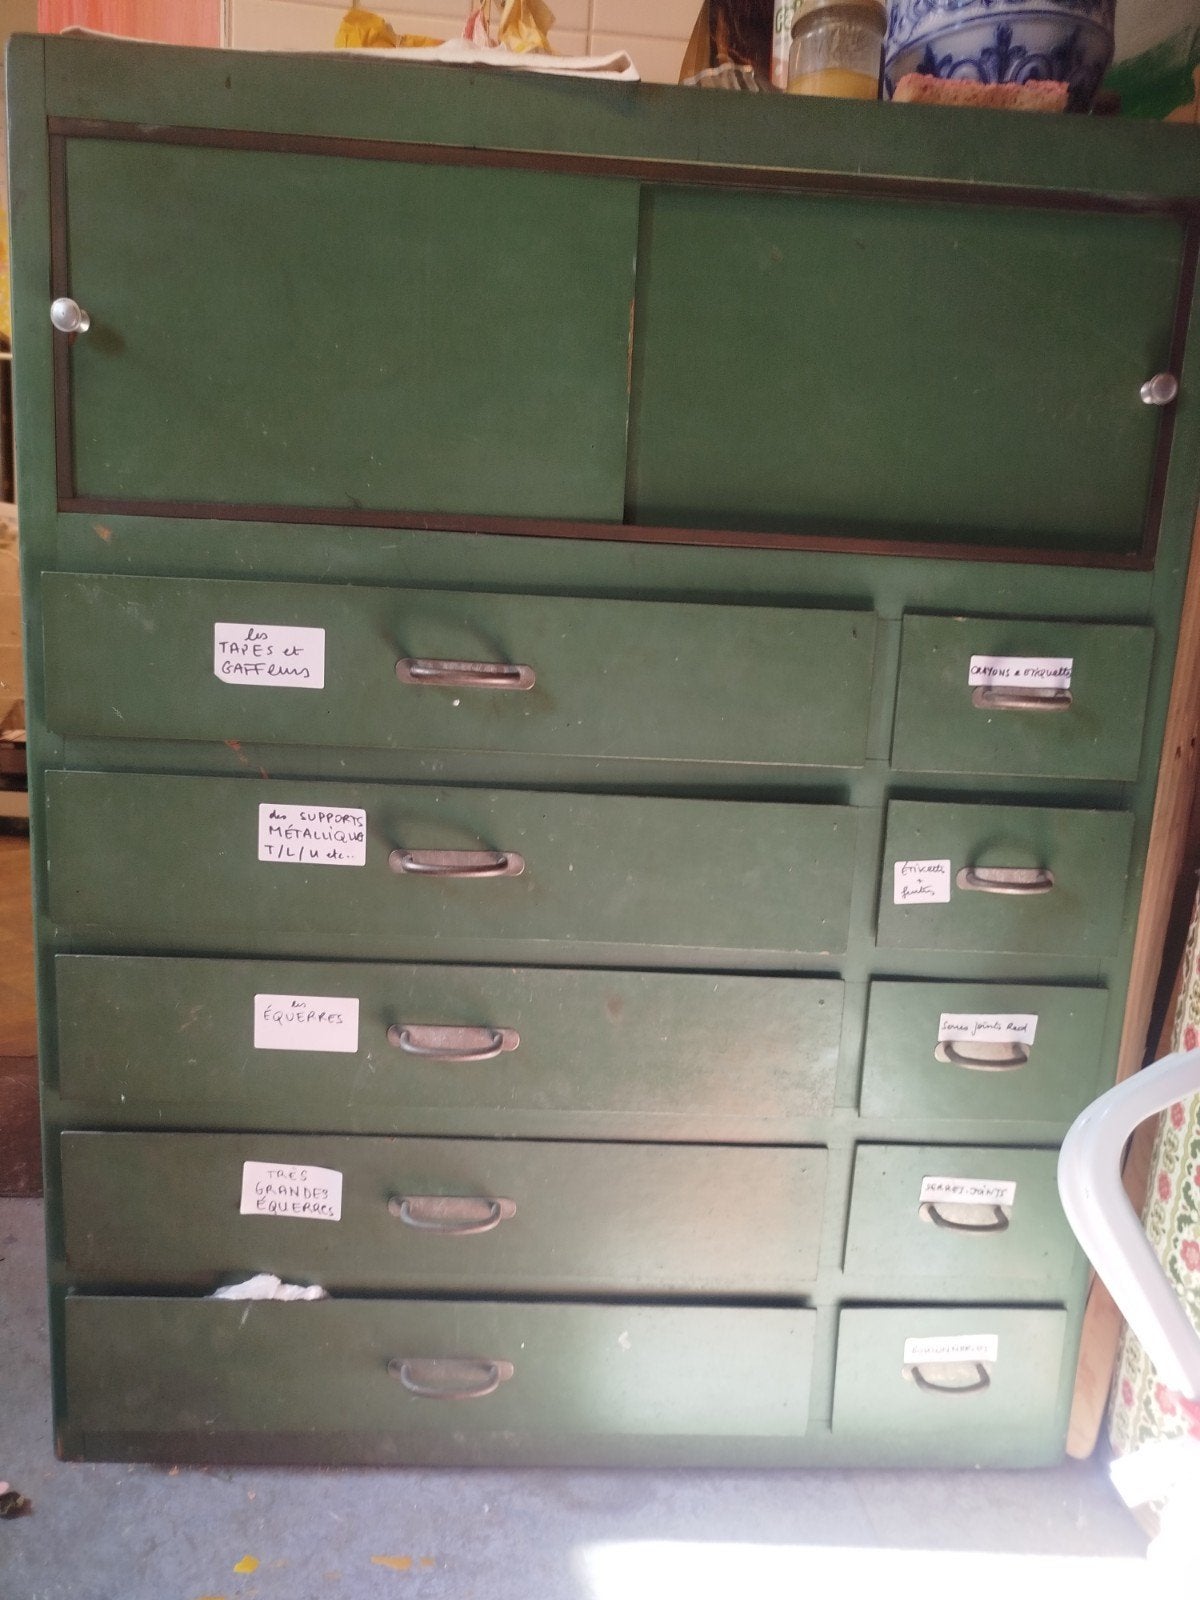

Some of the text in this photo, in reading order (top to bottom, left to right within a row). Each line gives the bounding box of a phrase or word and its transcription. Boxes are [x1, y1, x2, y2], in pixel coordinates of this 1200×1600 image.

[245, 628, 268, 641] les
[219, 642, 304, 657] TAPES et
[300, 811, 363, 827] SUPPORTS
[255, 1182, 328, 1199] GRANDES
